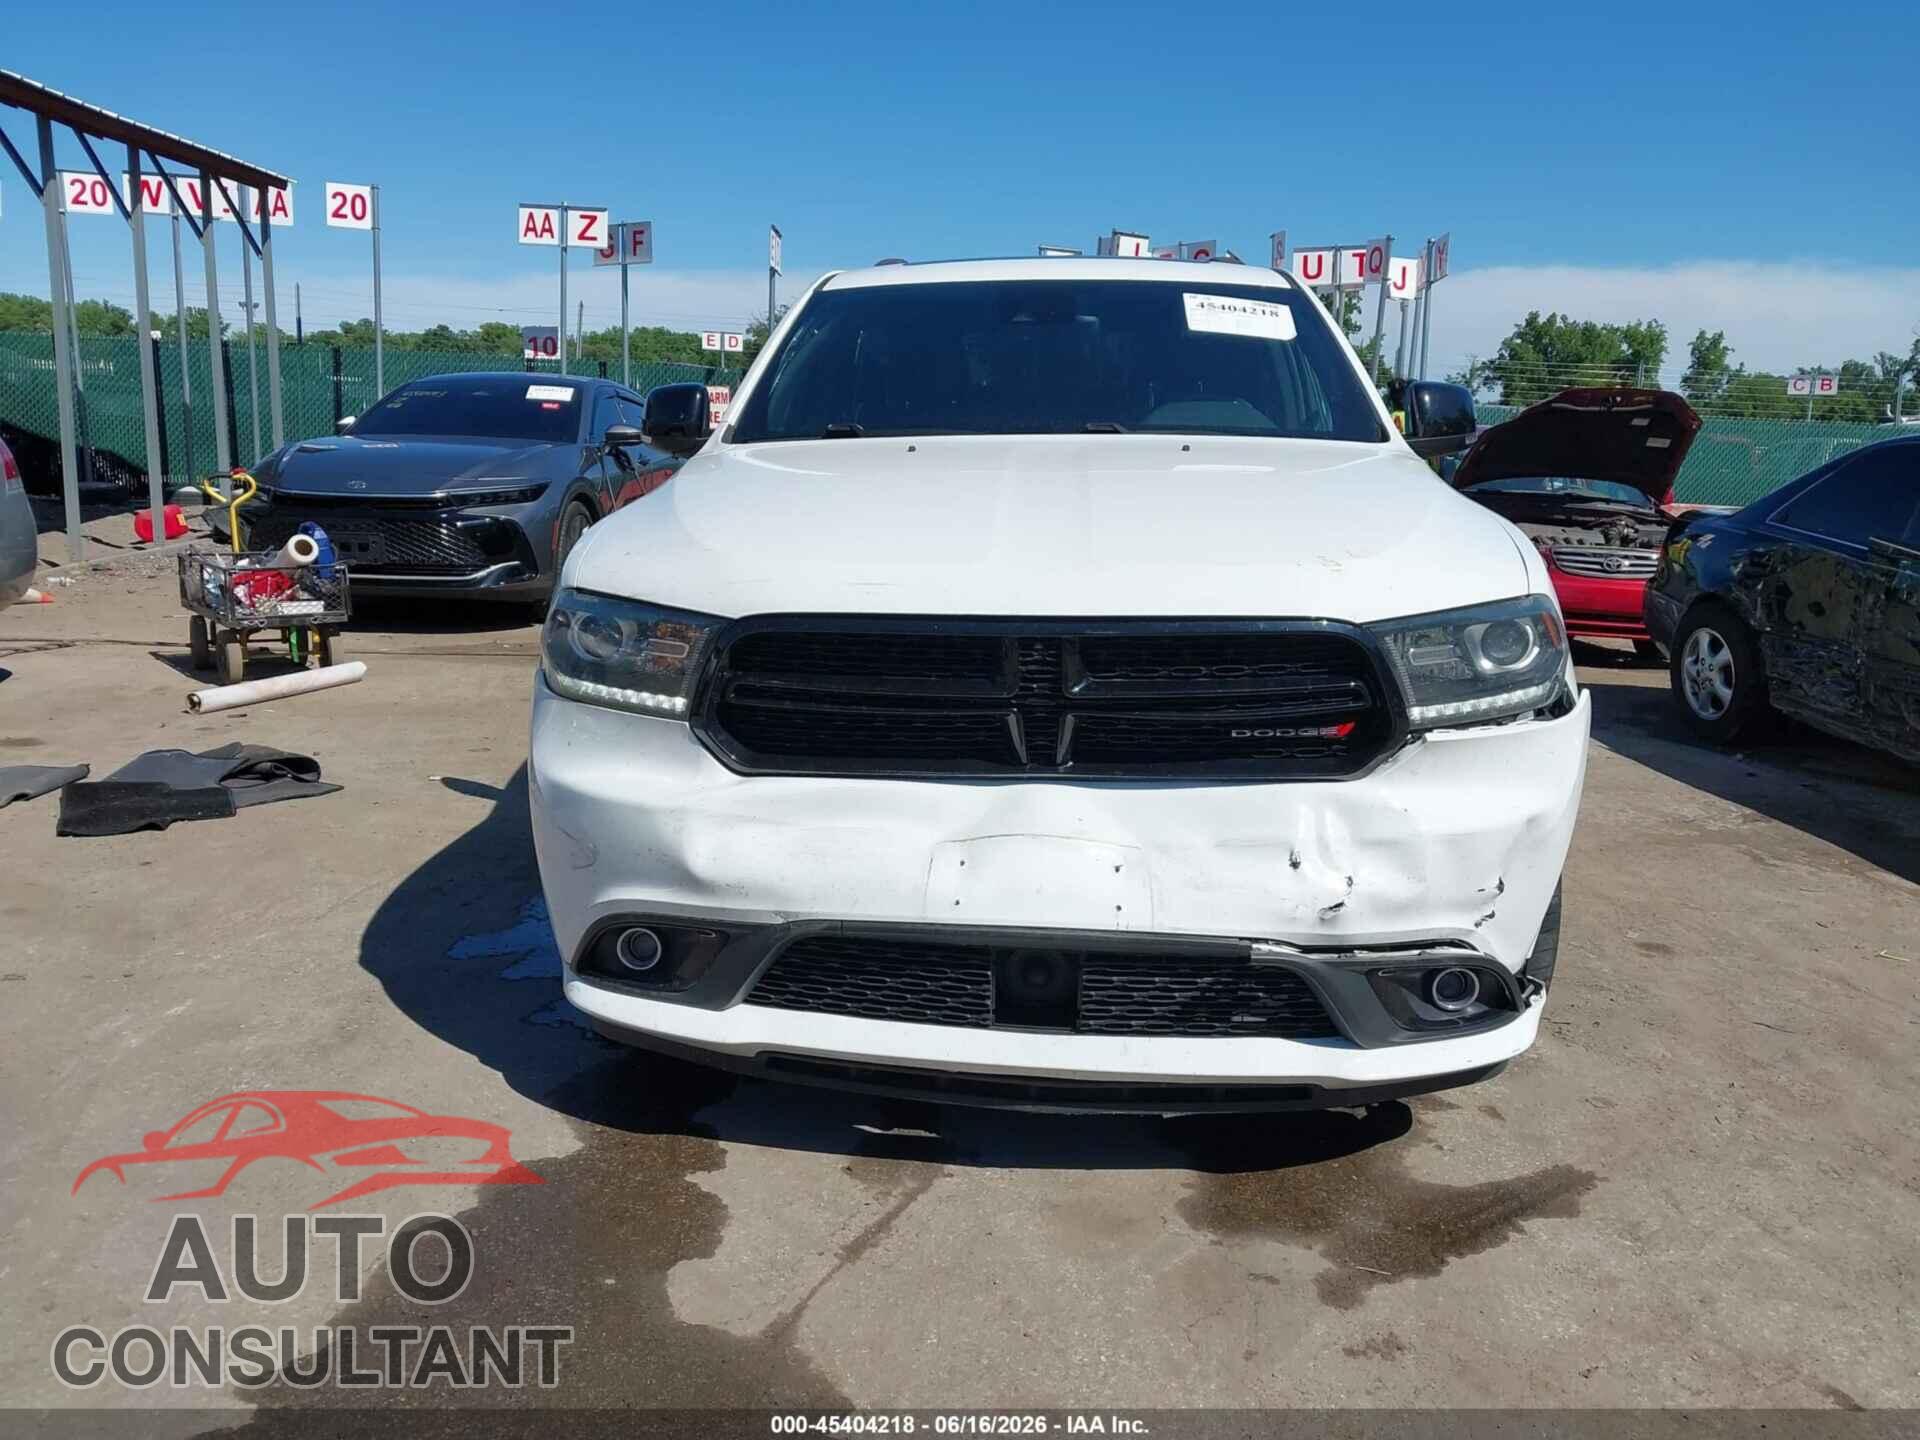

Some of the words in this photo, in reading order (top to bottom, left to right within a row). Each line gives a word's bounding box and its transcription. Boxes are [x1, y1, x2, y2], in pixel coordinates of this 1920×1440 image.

[70, 178, 108, 207] 20
[331, 191, 367, 221] 20
[523, 211, 555, 240] AA
[577, 214, 598, 241] Z
[632, 229, 645, 257] F
[1302, 254, 1323, 280] U
[1369, 246, 1384, 274] Q
[1393, 266, 1407, 290] J
[528, 335, 559, 358] 10
[706, 334, 717, 347] E
[728, 335, 739, 348] D
[1820, 378, 1833, 391] B
[1231, 727, 1339, 738] DODGE
